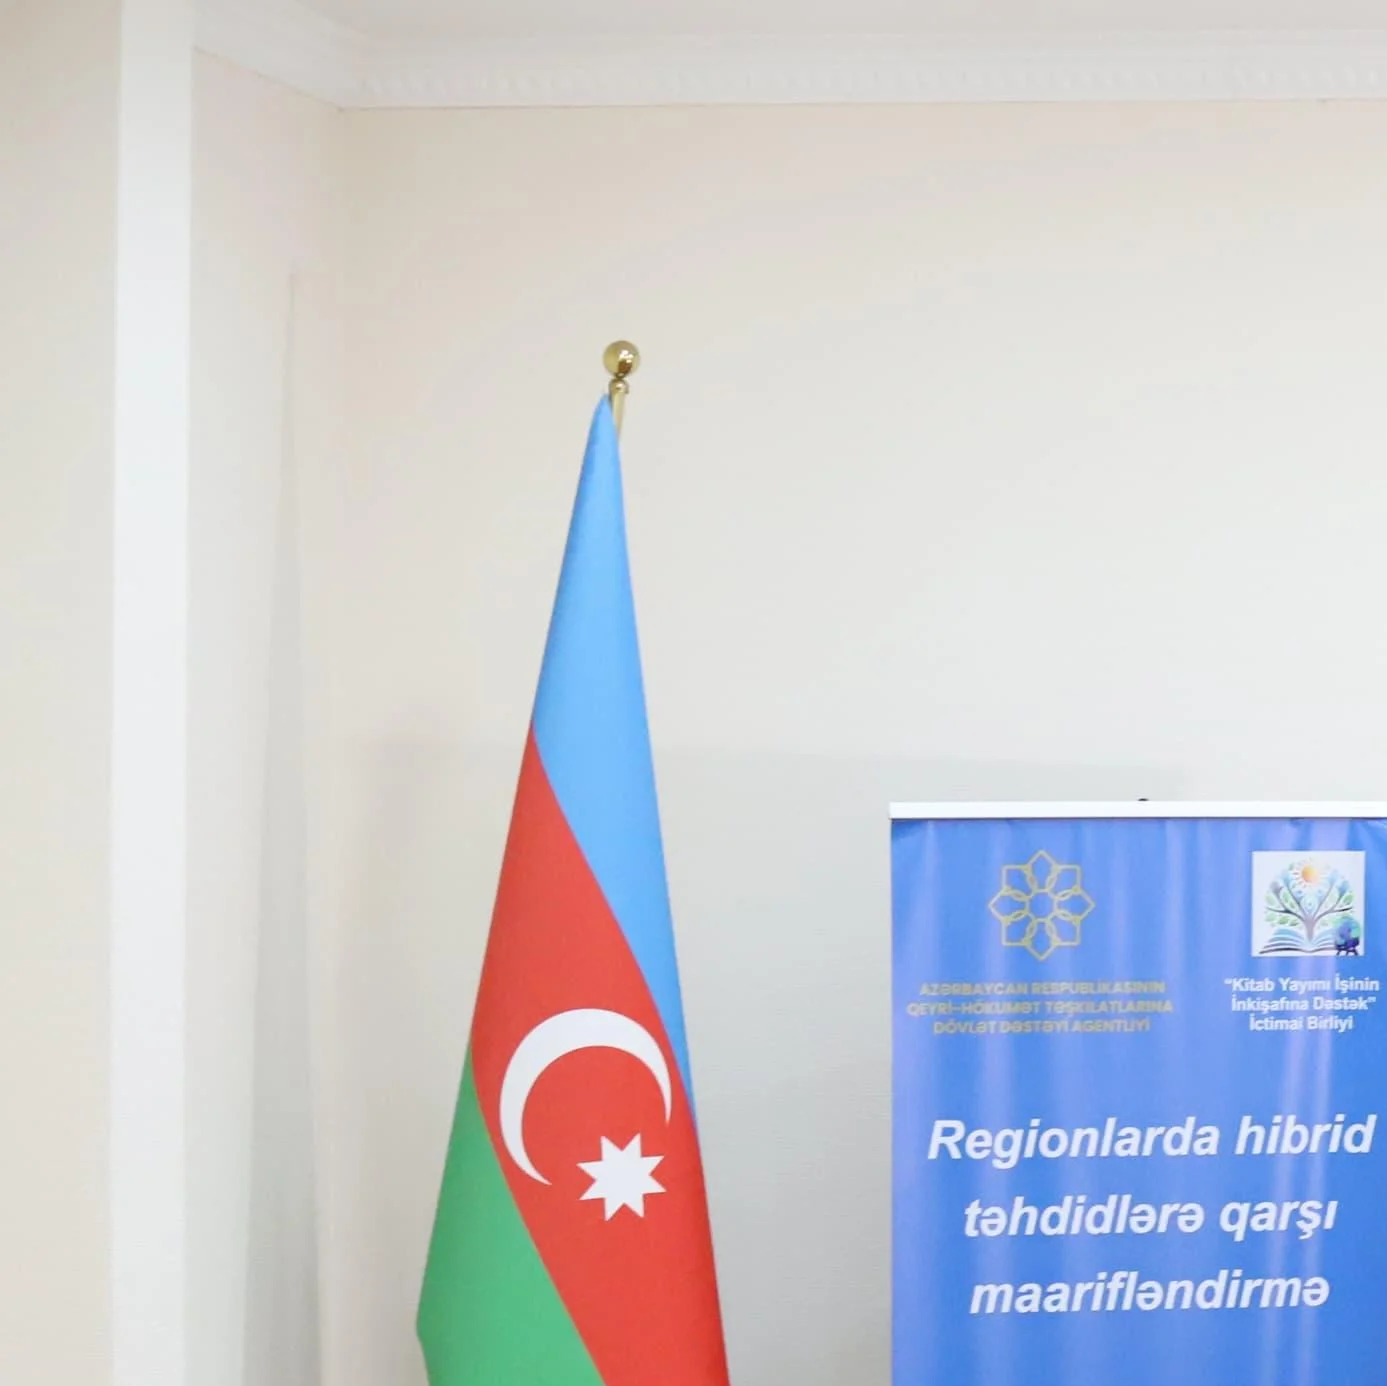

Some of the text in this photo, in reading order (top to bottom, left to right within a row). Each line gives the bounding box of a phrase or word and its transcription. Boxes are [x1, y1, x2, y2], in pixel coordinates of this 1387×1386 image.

[920, 981, 1028, 995] AZƏRBAYCAN
[1279, 976, 1331, 994] Yayımı
[1335, 973, 1380, 993] İşinin
[1231, 994, 1308, 1014] İnkişafına
[933, 1017, 998, 1035] DÖVLƏT
[1249, 1013, 1353, 1032] İctimai Birliyi
[928, 1114, 1377, 1169] Regionlarda hibrid
[964, 1194, 1337, 1241] təhdidlərə qarşı
[969, 1269, 1330, 1315] maarifləndirmə
